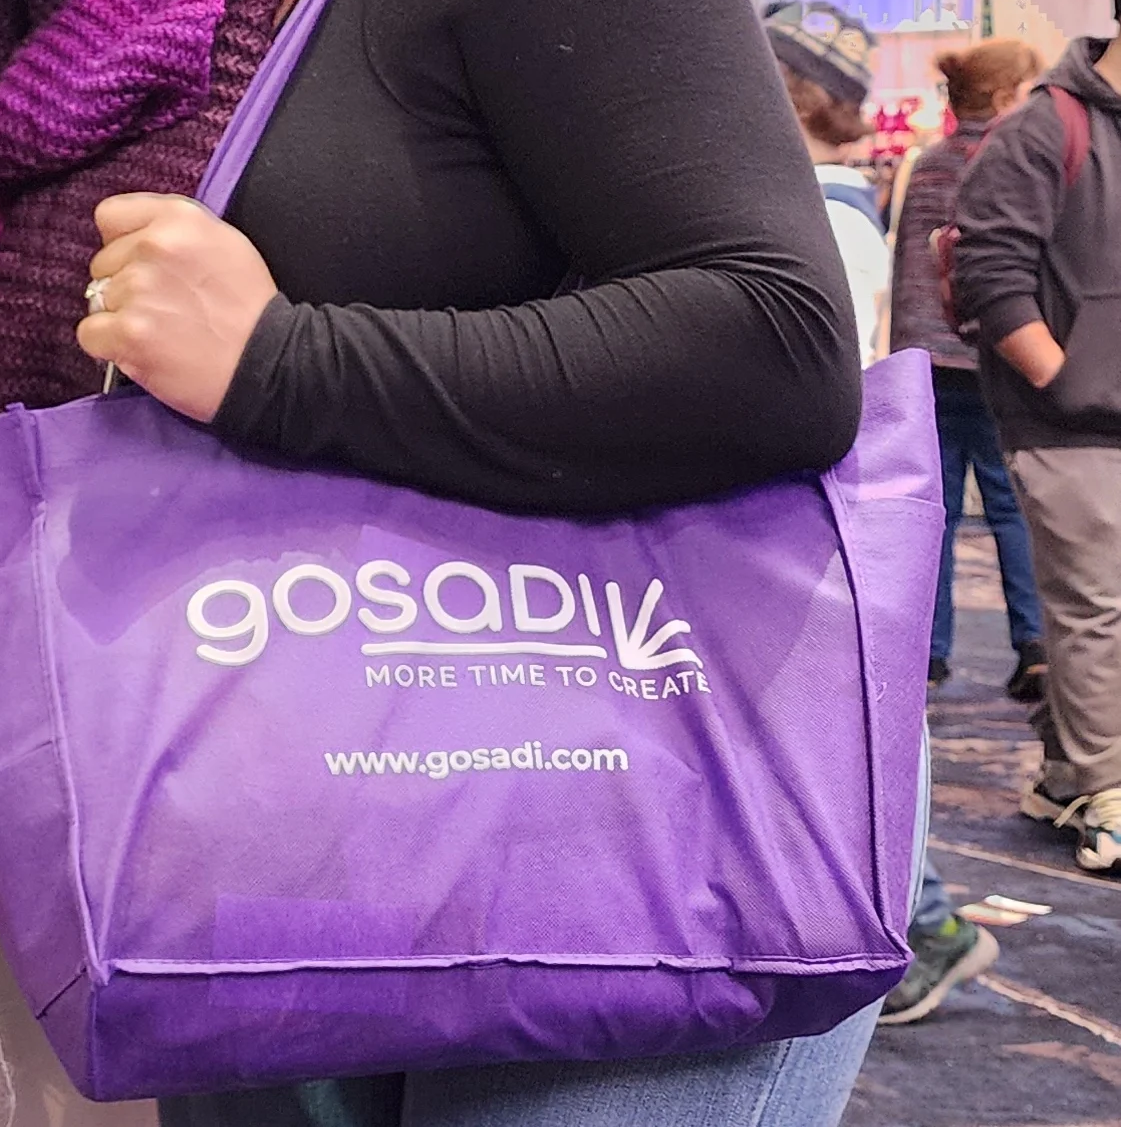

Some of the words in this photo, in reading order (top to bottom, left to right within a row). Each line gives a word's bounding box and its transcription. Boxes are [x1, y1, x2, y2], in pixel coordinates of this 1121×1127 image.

[364, 663, 458, 688] MORE
[467, 663, 547, 687] TIME
[555, 665, 598, 687] TO
[608, 670, 712, 700] CREATE
[324, 740, 629, 780] www.gosadi.com
